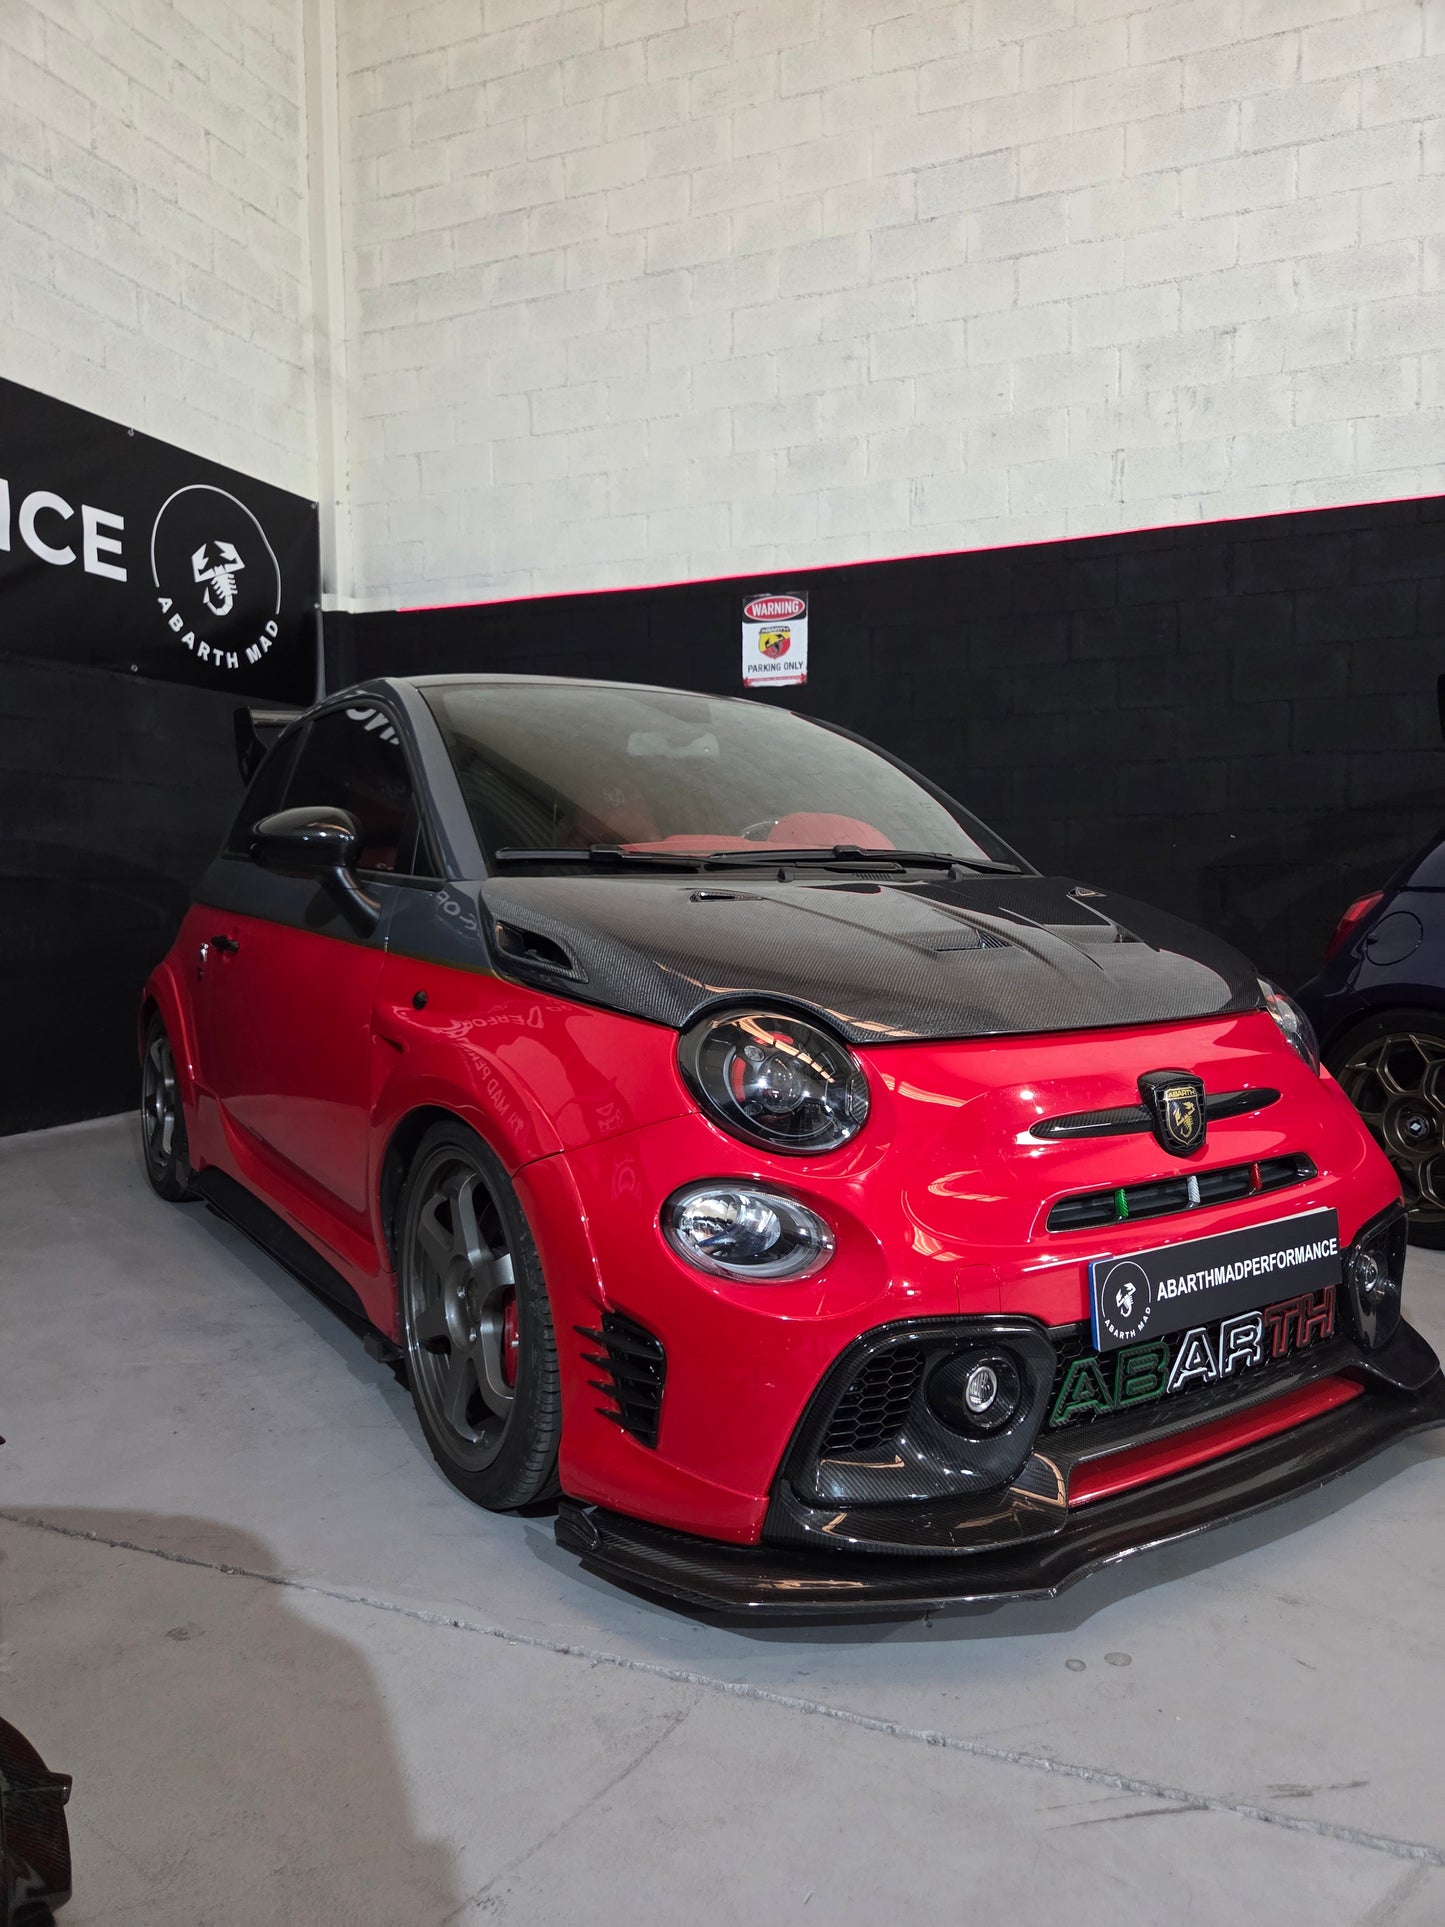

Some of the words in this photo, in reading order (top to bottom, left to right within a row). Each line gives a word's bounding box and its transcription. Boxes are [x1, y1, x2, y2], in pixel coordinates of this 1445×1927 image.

[0, 478, 127, 582] CE
[157, 597, 239, 669] ABARTH
[245, 620, 279, 664] MAD
[751, 600, 800, 617] WARNING
[747, 663, 782, 674] PARKING
[783, 661, 804, 671] ONLY
[1168, 1088, 1196, 1098] ABARTH
[1156, 1237, 1338, 1301] ABARTHMADPERFORMANCE
[1104, 1319, 1136, 1340] ABARTH
[1137, 1306, 1151, 1332] MAD
[1049, 1285, 1336, 1428] ABARTH
